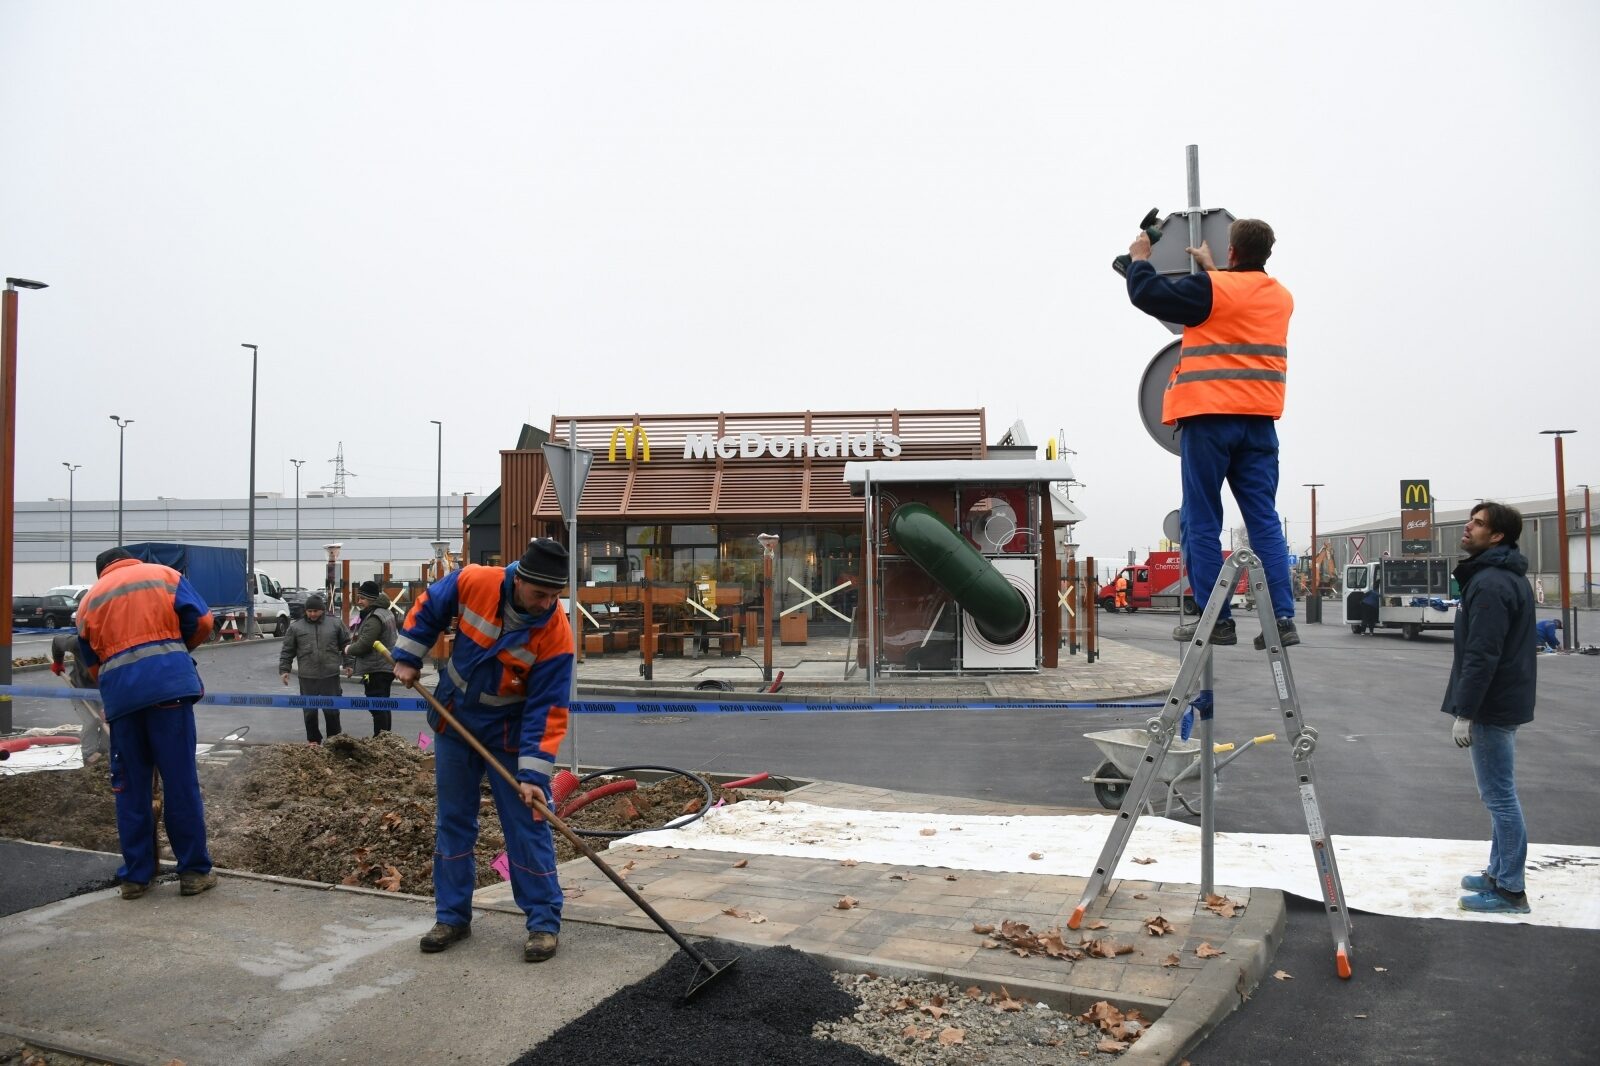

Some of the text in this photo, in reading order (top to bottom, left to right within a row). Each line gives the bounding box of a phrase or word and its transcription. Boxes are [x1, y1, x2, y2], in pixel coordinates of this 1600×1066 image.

[683, 431, 902, 459] McDonald's
[351, 698, 399, 709] POZOR VODOVOD
[416, 700, 430, 709] POZ
[568, 703, 616, 712] ZOR VODOVOD
[719, 704, 783, 712] POZOR VODOVOD
[636, 704, 698, 713] POZOR VODOVOD
